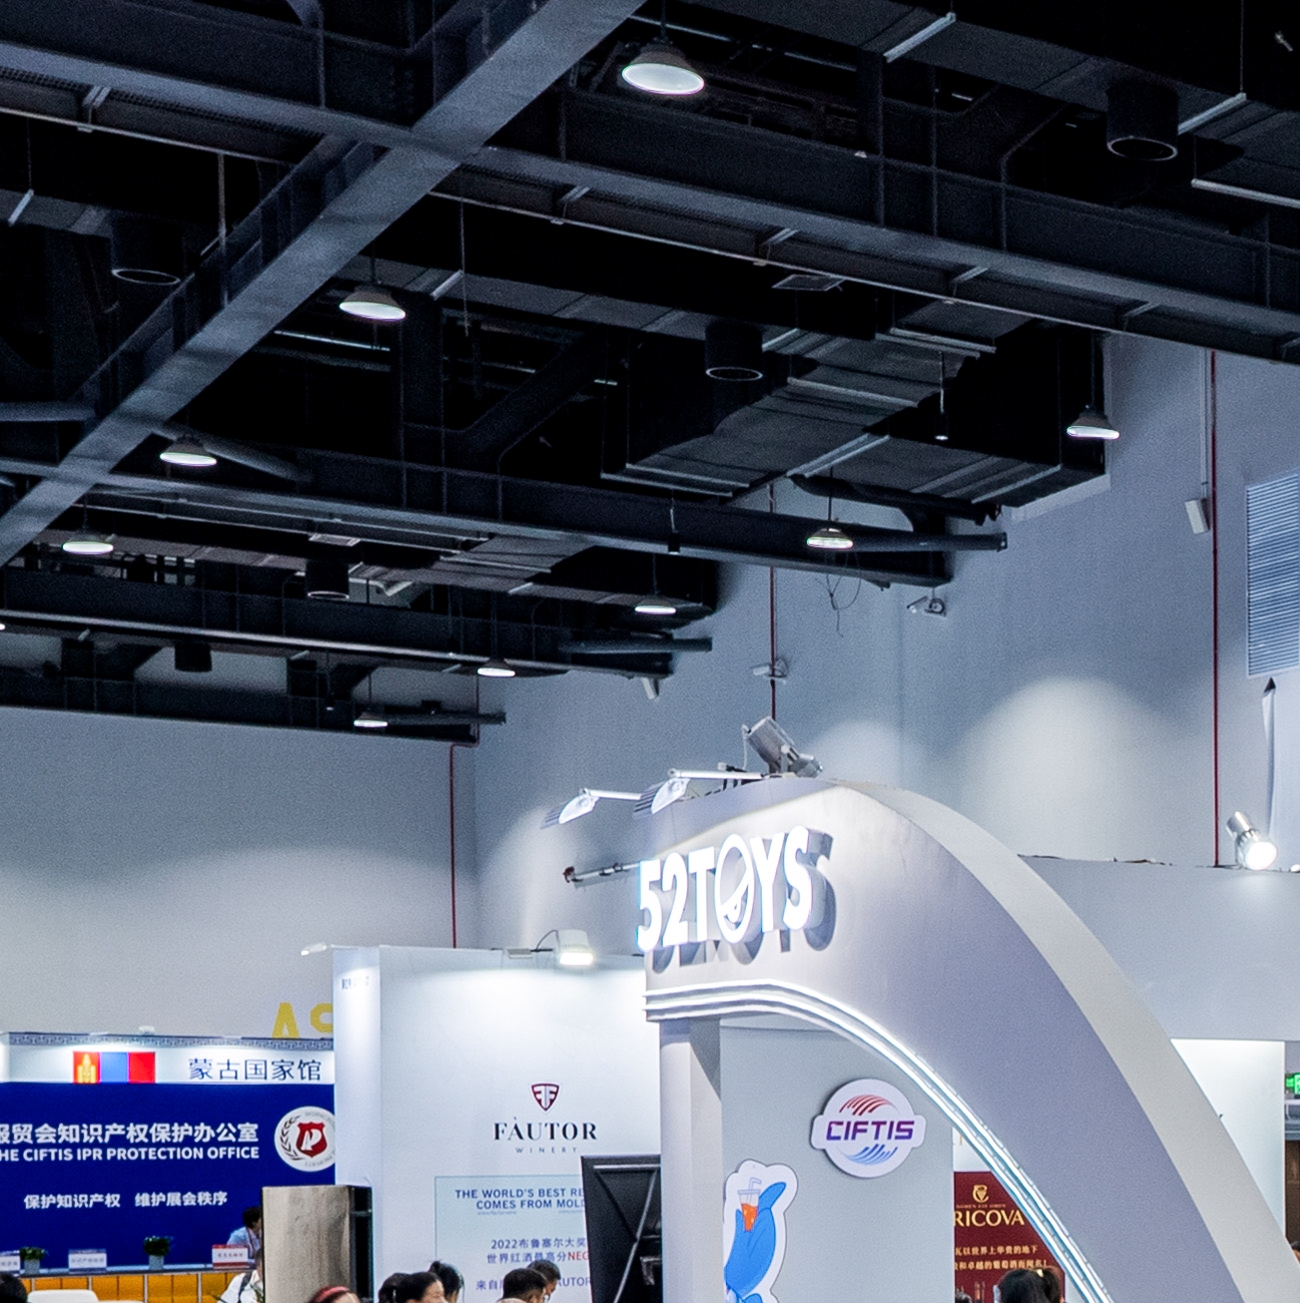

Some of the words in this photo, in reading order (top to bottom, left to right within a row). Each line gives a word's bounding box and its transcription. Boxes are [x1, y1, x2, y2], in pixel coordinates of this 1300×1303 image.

[635, 825, 814, 953] 52TOYS
[188, 1057, 322, 1082] 蒙古国家馆
[826, 1120, 915, 1141] CIFTIS
[0, 1149, 19, 1161] HE
[23, 1148, 73, 1161] CIFTIS
[77, 1148, 103, 1160] IPR
[106, 1147, 203, 1160] PROTECTION
[207, 1146, 259, 1159] OFFICE
[515, 1146, 578, 1154] WINERY
[24, 1193, 121, 1209] 保护知识产权
[134, 1191, 228, 1207] 维护展会秩序
[455, 1189, 478, 1199] THE
[482, 1188, 534, 1198] WORLD'S
[538, 1188, 566, 1197] BEST
[476, 1200, 517, 1210] COMES
[520, 1199, 552, 1209] FROM
